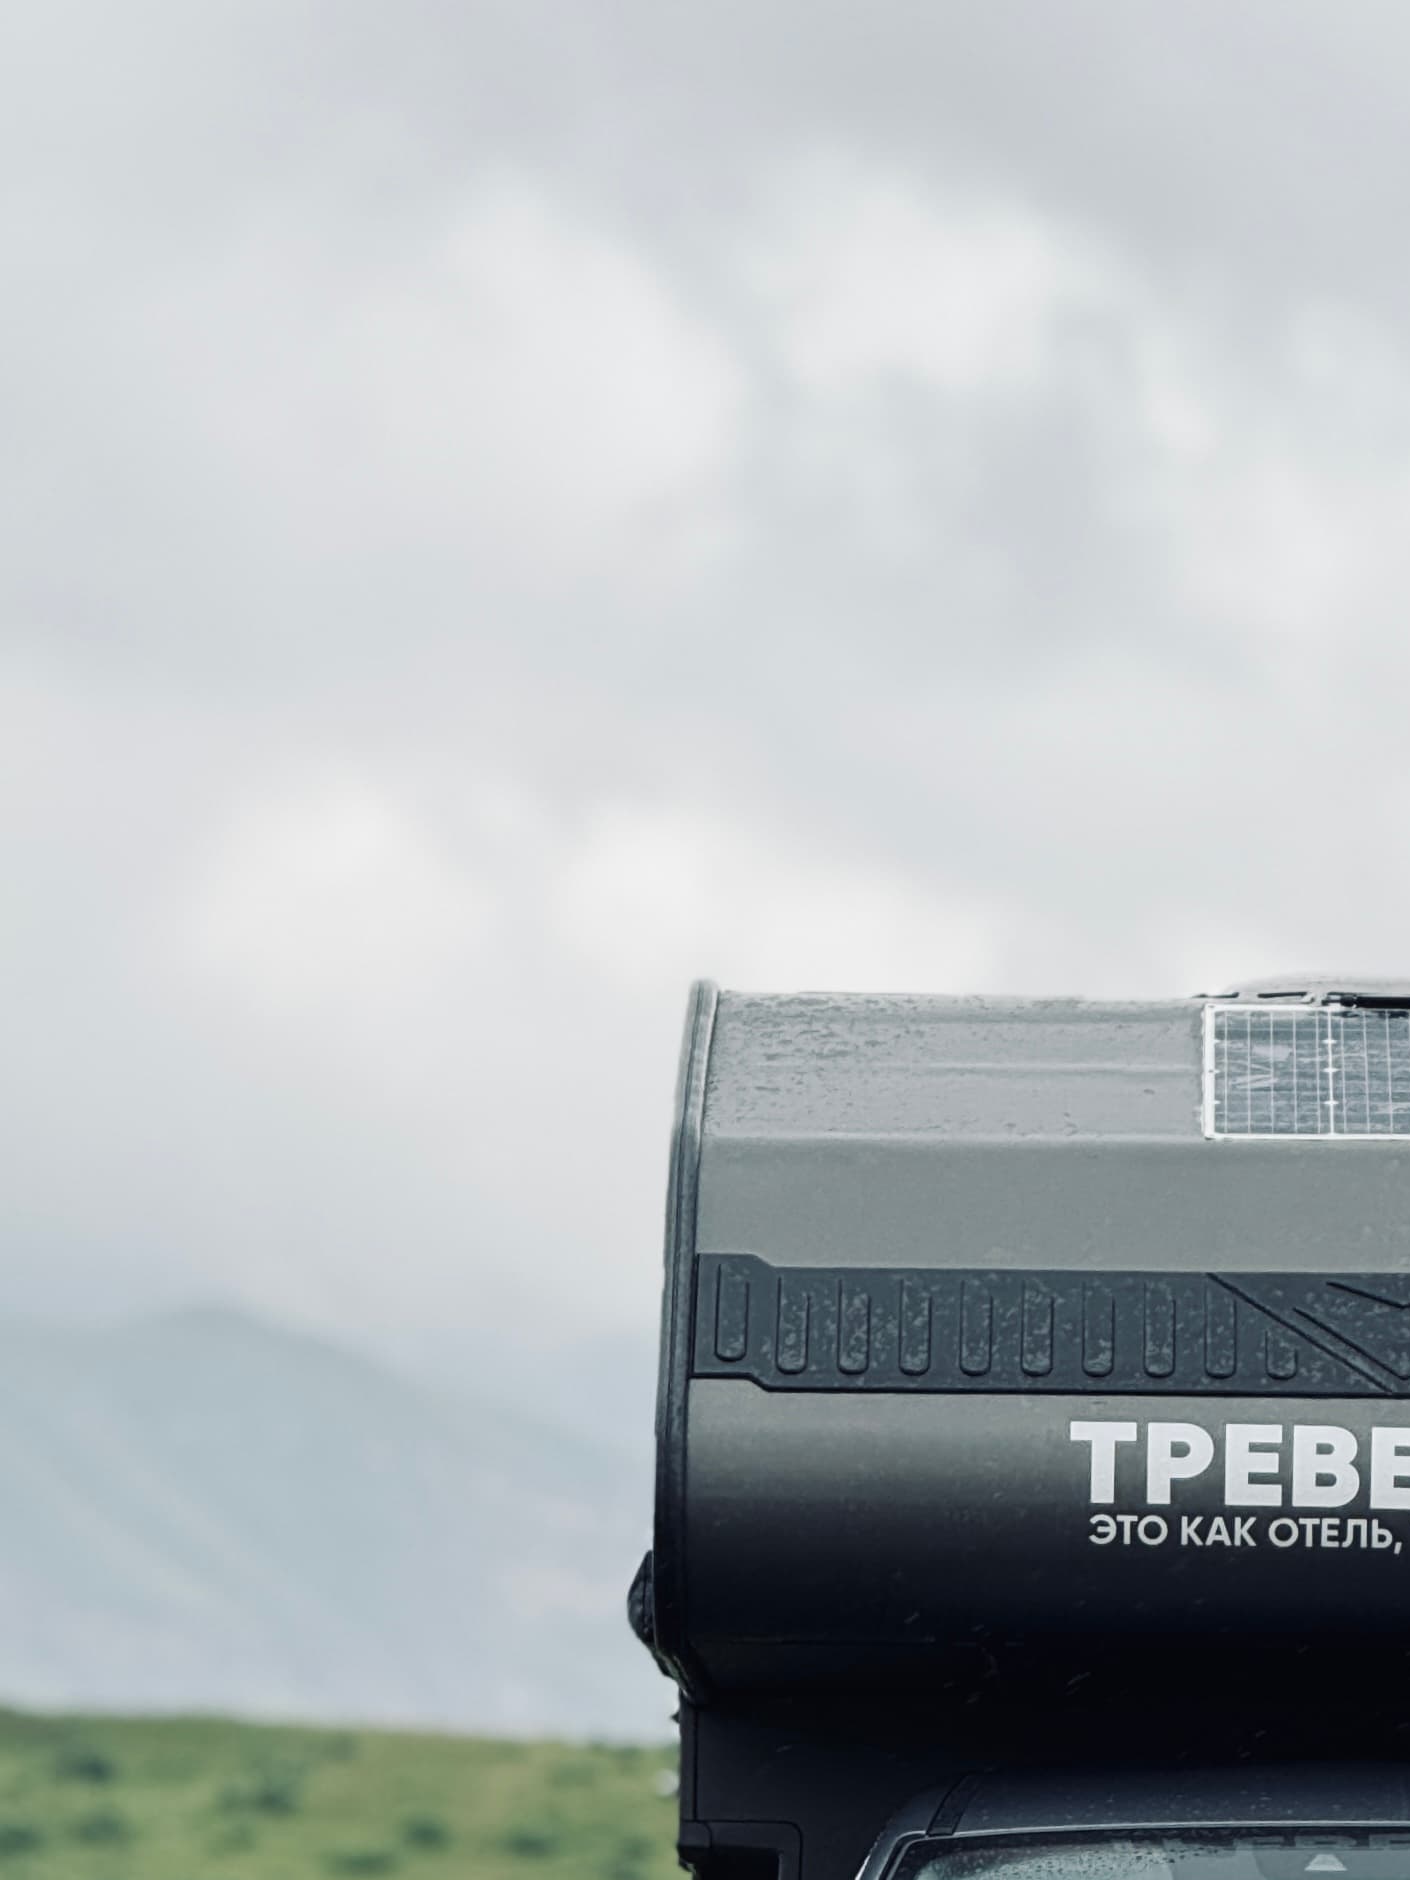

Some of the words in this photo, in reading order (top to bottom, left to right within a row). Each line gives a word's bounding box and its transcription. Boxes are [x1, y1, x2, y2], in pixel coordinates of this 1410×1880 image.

[1088, 1514, 1169, 1546] ЭТО
[1180, 1516, 1257, 1547] КАК
[1267, 1517, 1402, 1554] ОТЕЛЬ,
